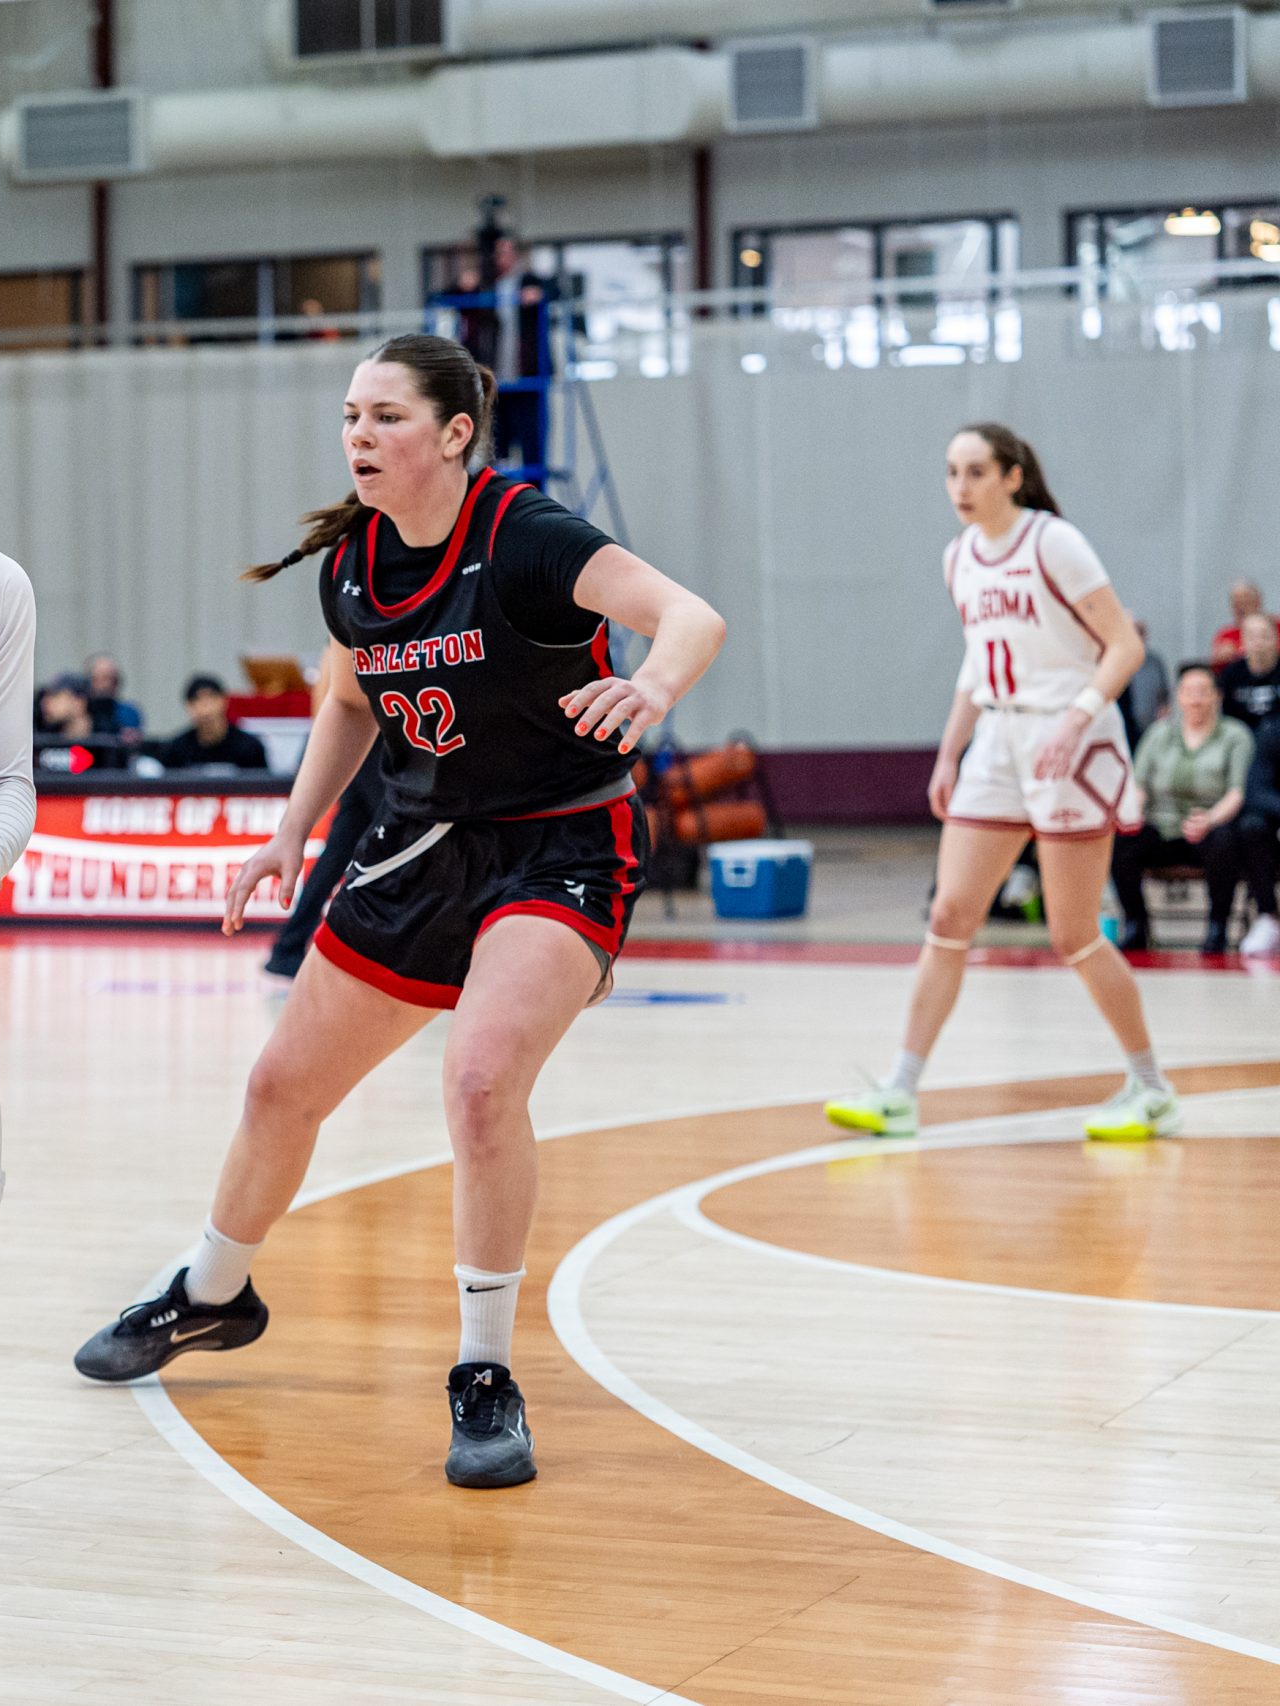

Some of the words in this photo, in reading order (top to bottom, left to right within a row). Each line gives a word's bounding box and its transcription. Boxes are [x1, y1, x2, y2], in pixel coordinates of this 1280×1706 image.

[353, 629, 485, 675] ARLETON
[987, 639, 1016, 699] 11
[380, 686, 466, 757] 22
[174, 797, 221, 834] OF
[24, 851, 282, 902] THUNDER
